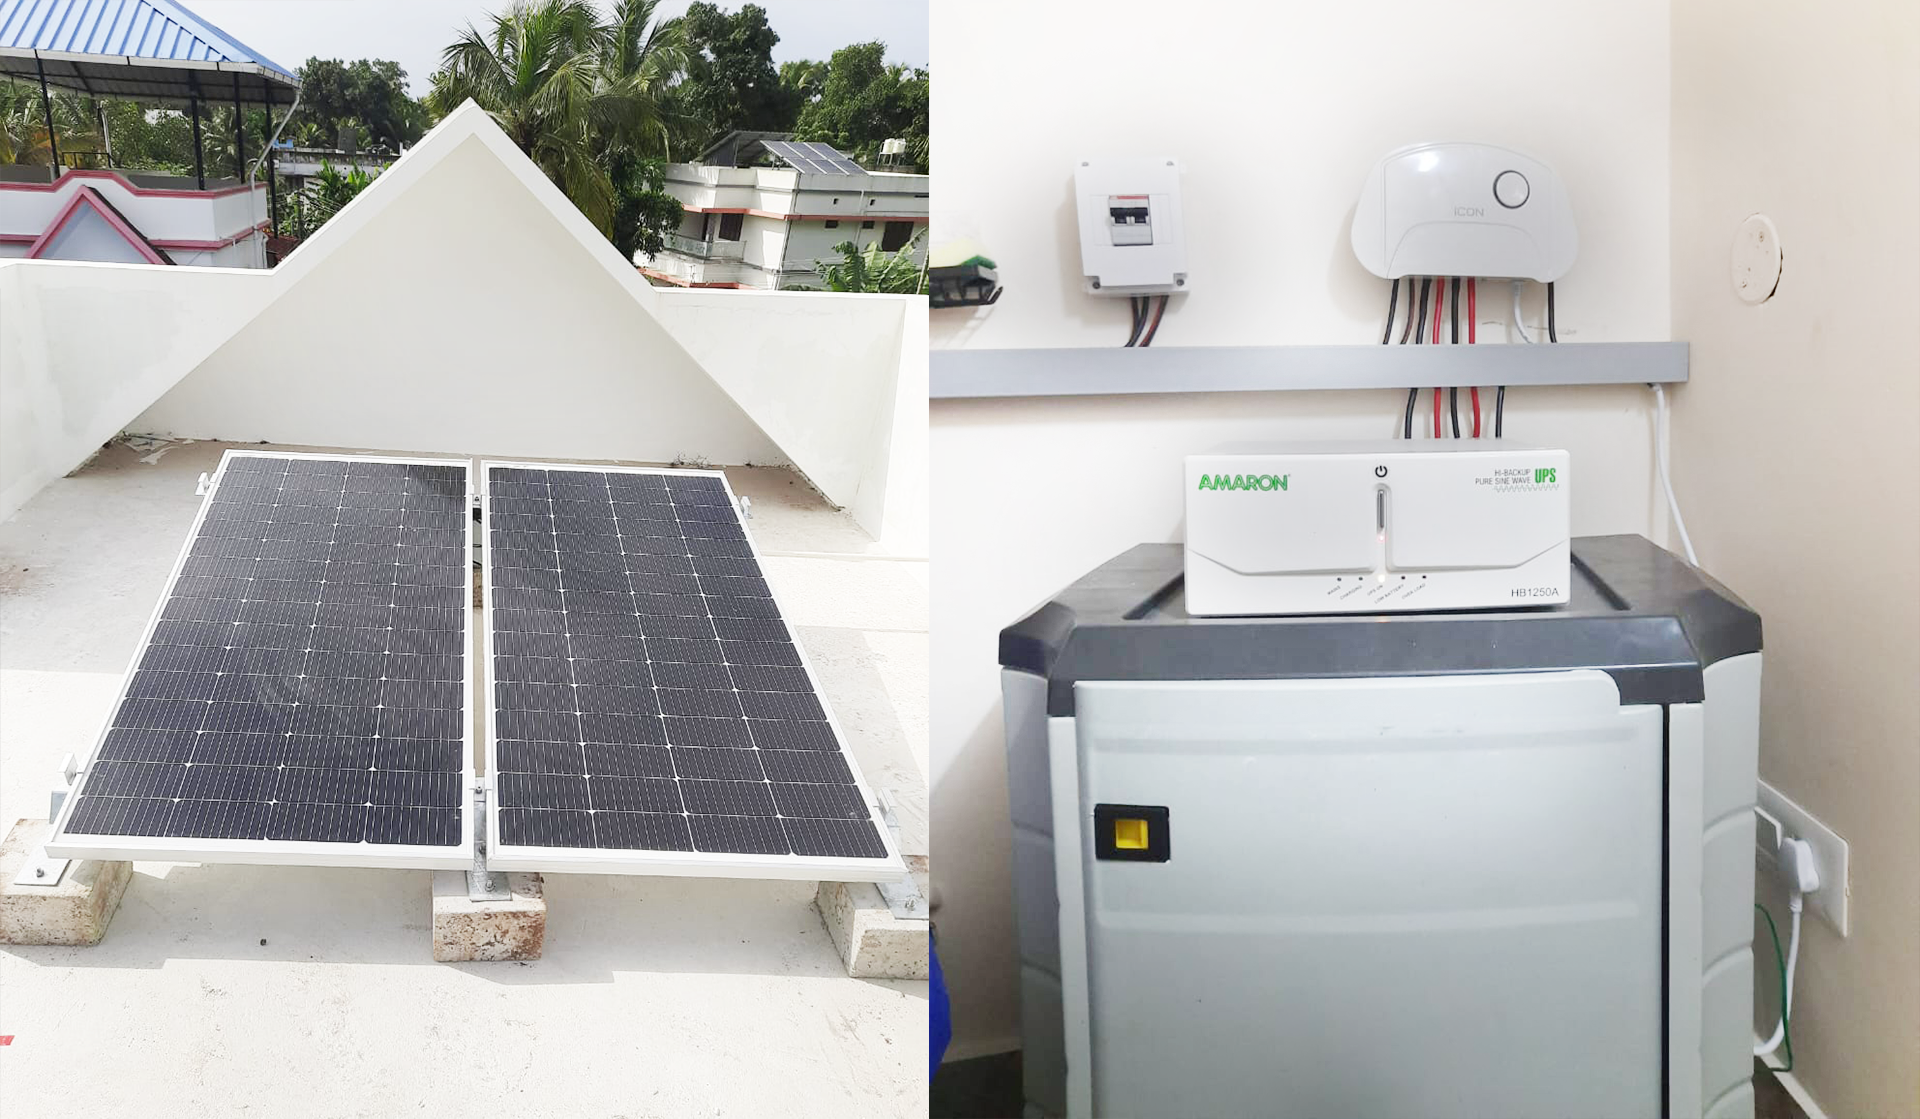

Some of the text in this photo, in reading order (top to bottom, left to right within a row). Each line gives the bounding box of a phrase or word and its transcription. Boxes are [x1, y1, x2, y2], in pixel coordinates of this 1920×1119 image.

[1494, 468, 1531, 477] HI-BACKUP
[1534, 467, 1557, 484] UPS
[1198, 473, 1288, 491] AMARON
[1475, 476, 1531, 486] PURE SINE WAVE
[1511, 587, 1560, 598] HB1250A
